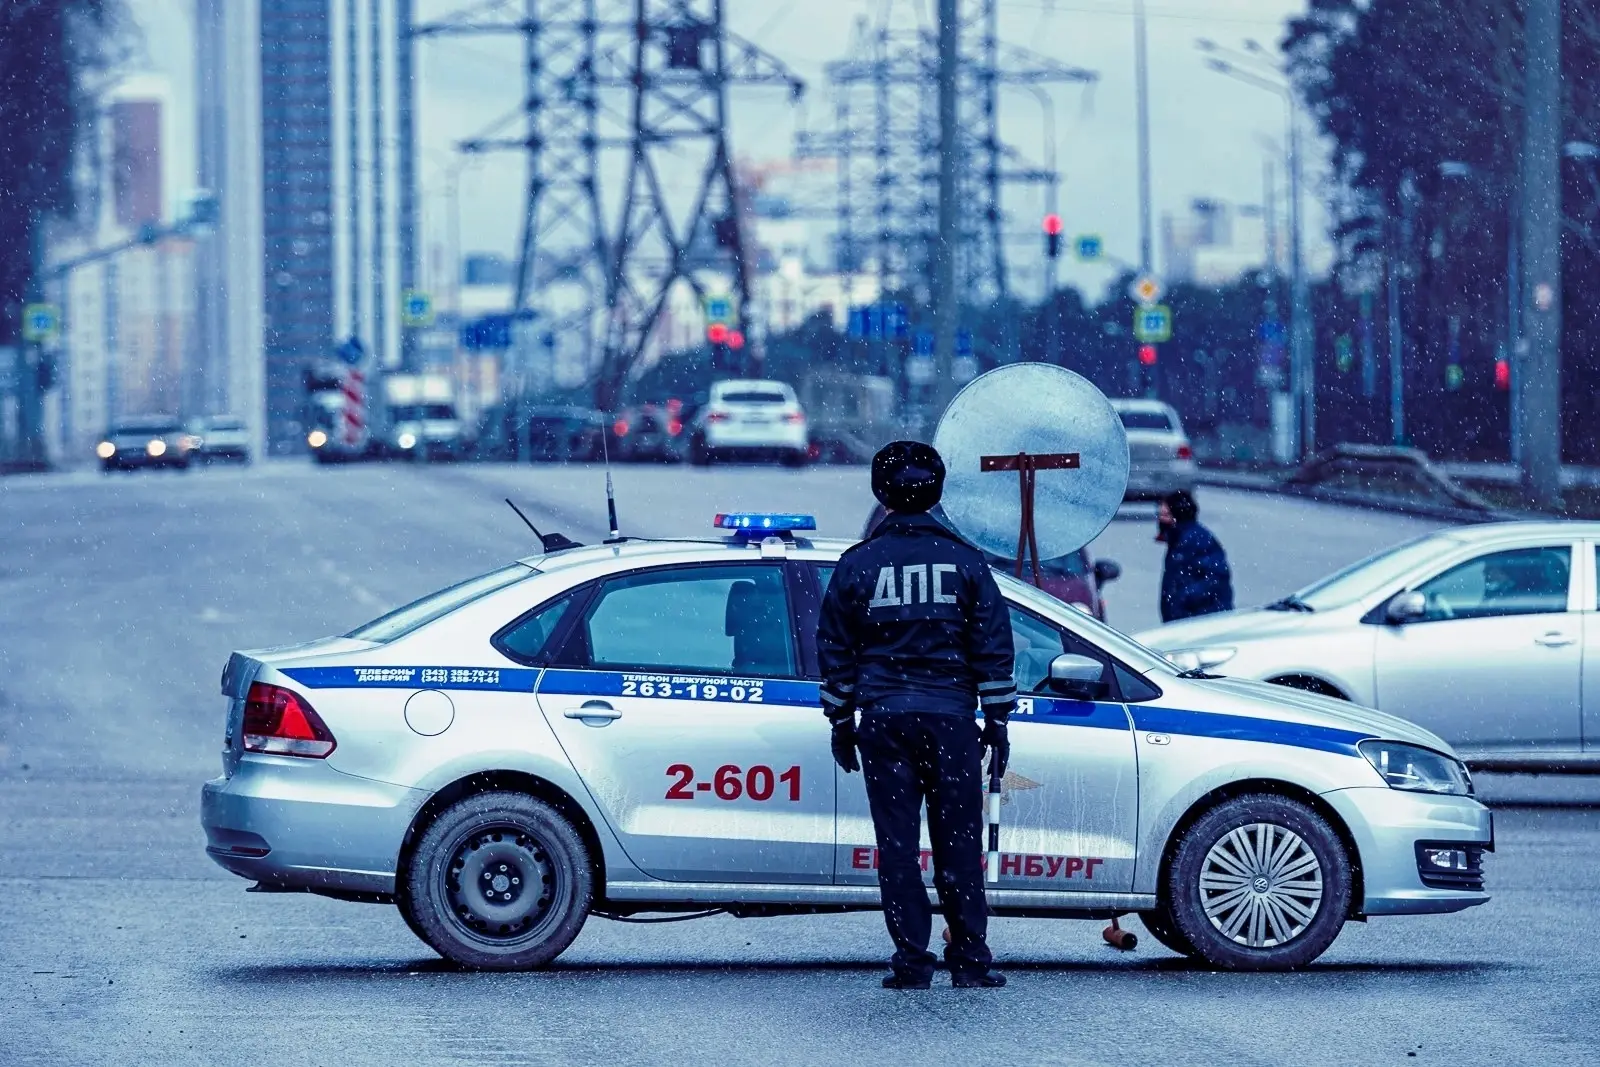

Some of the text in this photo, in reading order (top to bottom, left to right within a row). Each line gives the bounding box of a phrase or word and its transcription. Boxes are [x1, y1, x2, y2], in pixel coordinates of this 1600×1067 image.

[869, 563, 957, 608] ДПС
[353, 668, 416, 676] ТЕЛЕФОНЫ
[421, 669, 448, 677] (343)
[421, 676, 448, 684] (343)
[622, 674, 764, 687] ТЕЛЕФОН ДЕЖУРНОЙ ЧАСТИ
[621, 681, 763, 702] 263-19-02
[664, 763, 801, 802] 2-601
[852, 847, 1104, 880] ЕТНБУРГ
